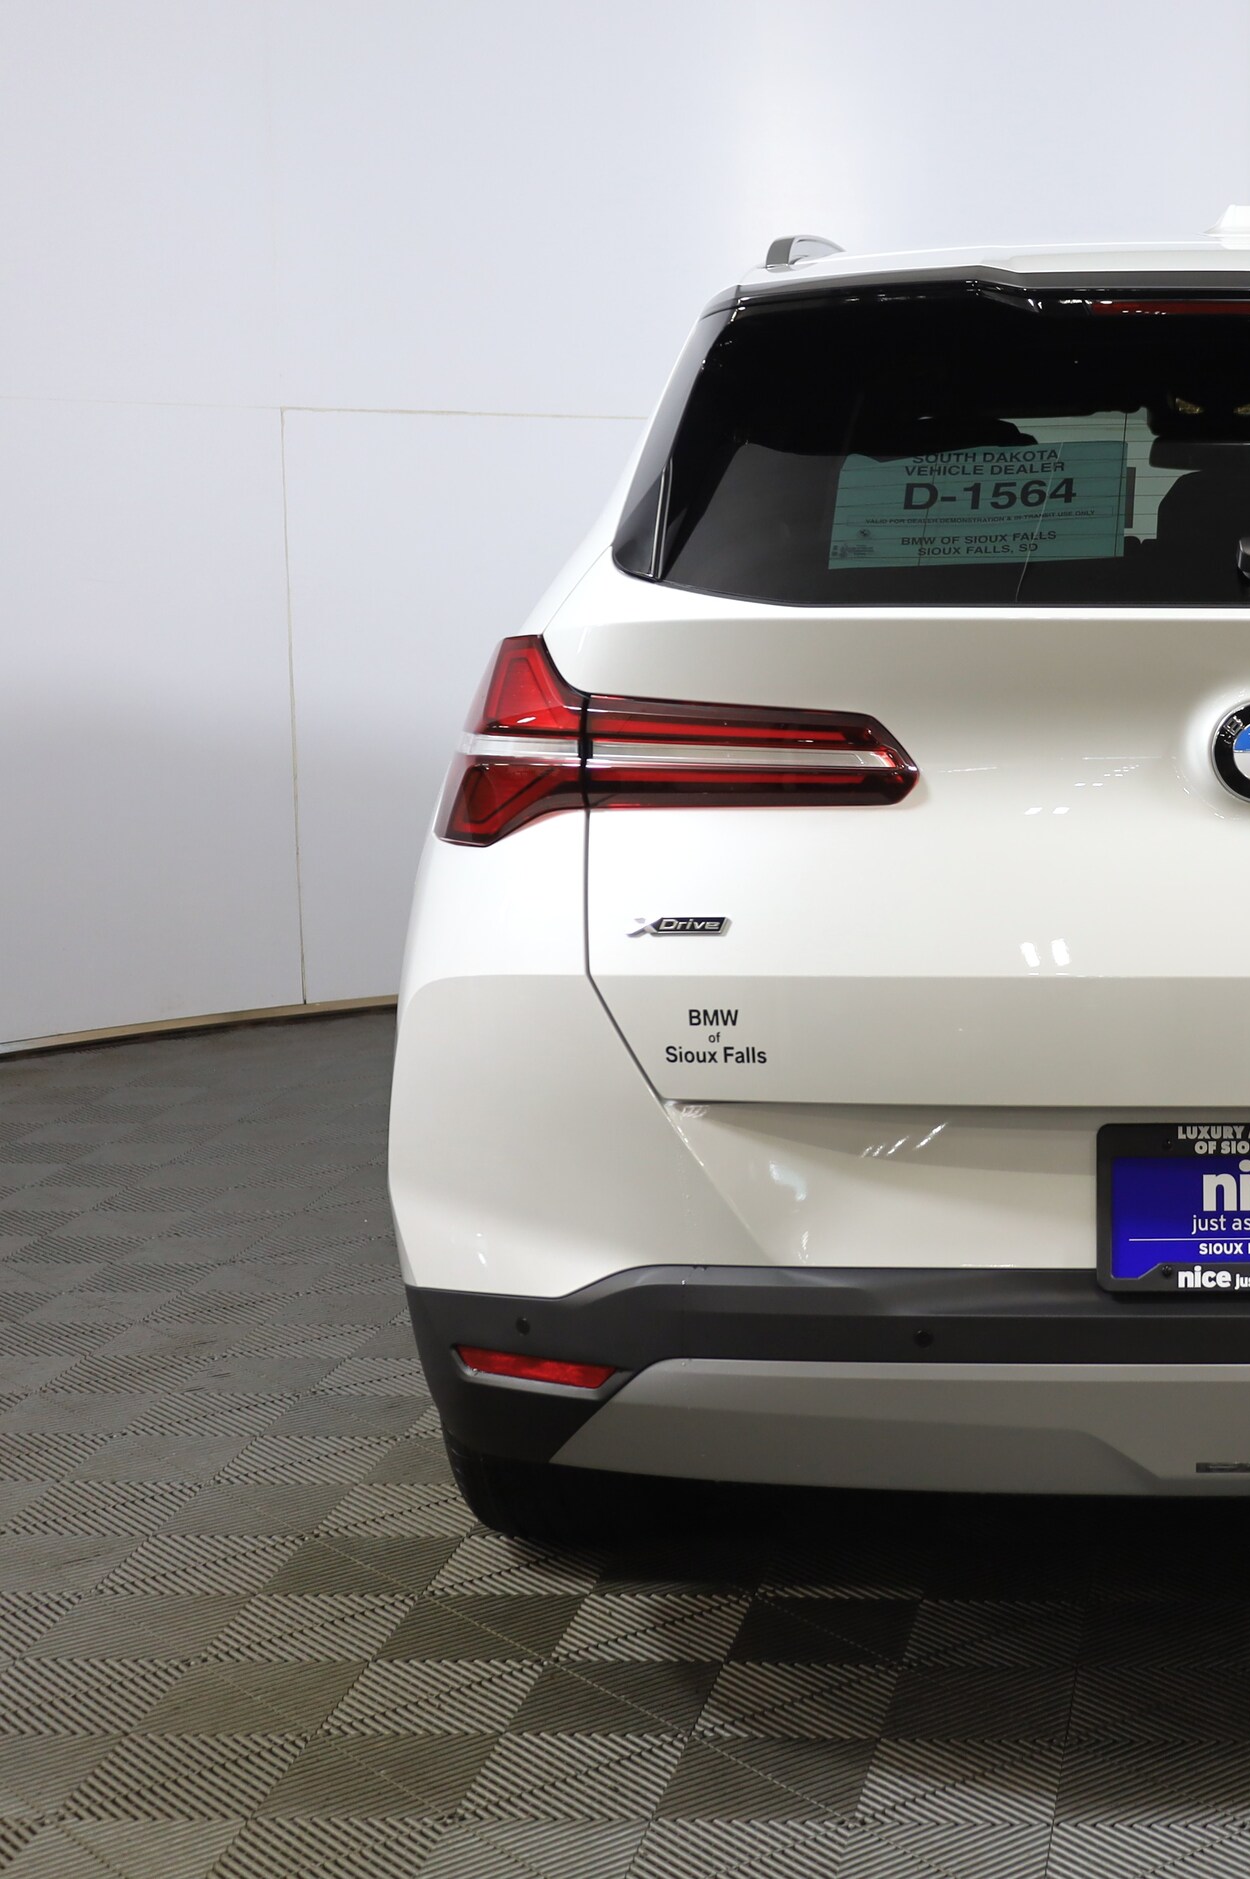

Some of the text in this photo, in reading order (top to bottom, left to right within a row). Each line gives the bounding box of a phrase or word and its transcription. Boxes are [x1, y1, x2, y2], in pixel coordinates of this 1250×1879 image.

[912, 449, 1059, 465] SOUTH DAKOTA
[905, 461, 1065, 477] VEHICLE DEALER
[903, 477, 1077, 511] D-1564
[901, 531, 1057, 546] BMW OF SIOUX FALLS
[918, 546, 964, 557] SIOUX
[1018, 542, 1038, 553] SD
[688, 1009, 739, 1026] BMW
[708, 1031, 721, 1043] of
[665, 1046, 768, 1064] Sioux Falls
[1177, 1125, 1245, 1139] LUXURY
[1194, 1140, 1217, 1154] OF
[1191, 1215, 1226, 1235] just
[1199, 1243, 1243, 1255] SIOUX
[1177, 1265, 1232, 1288] nice
